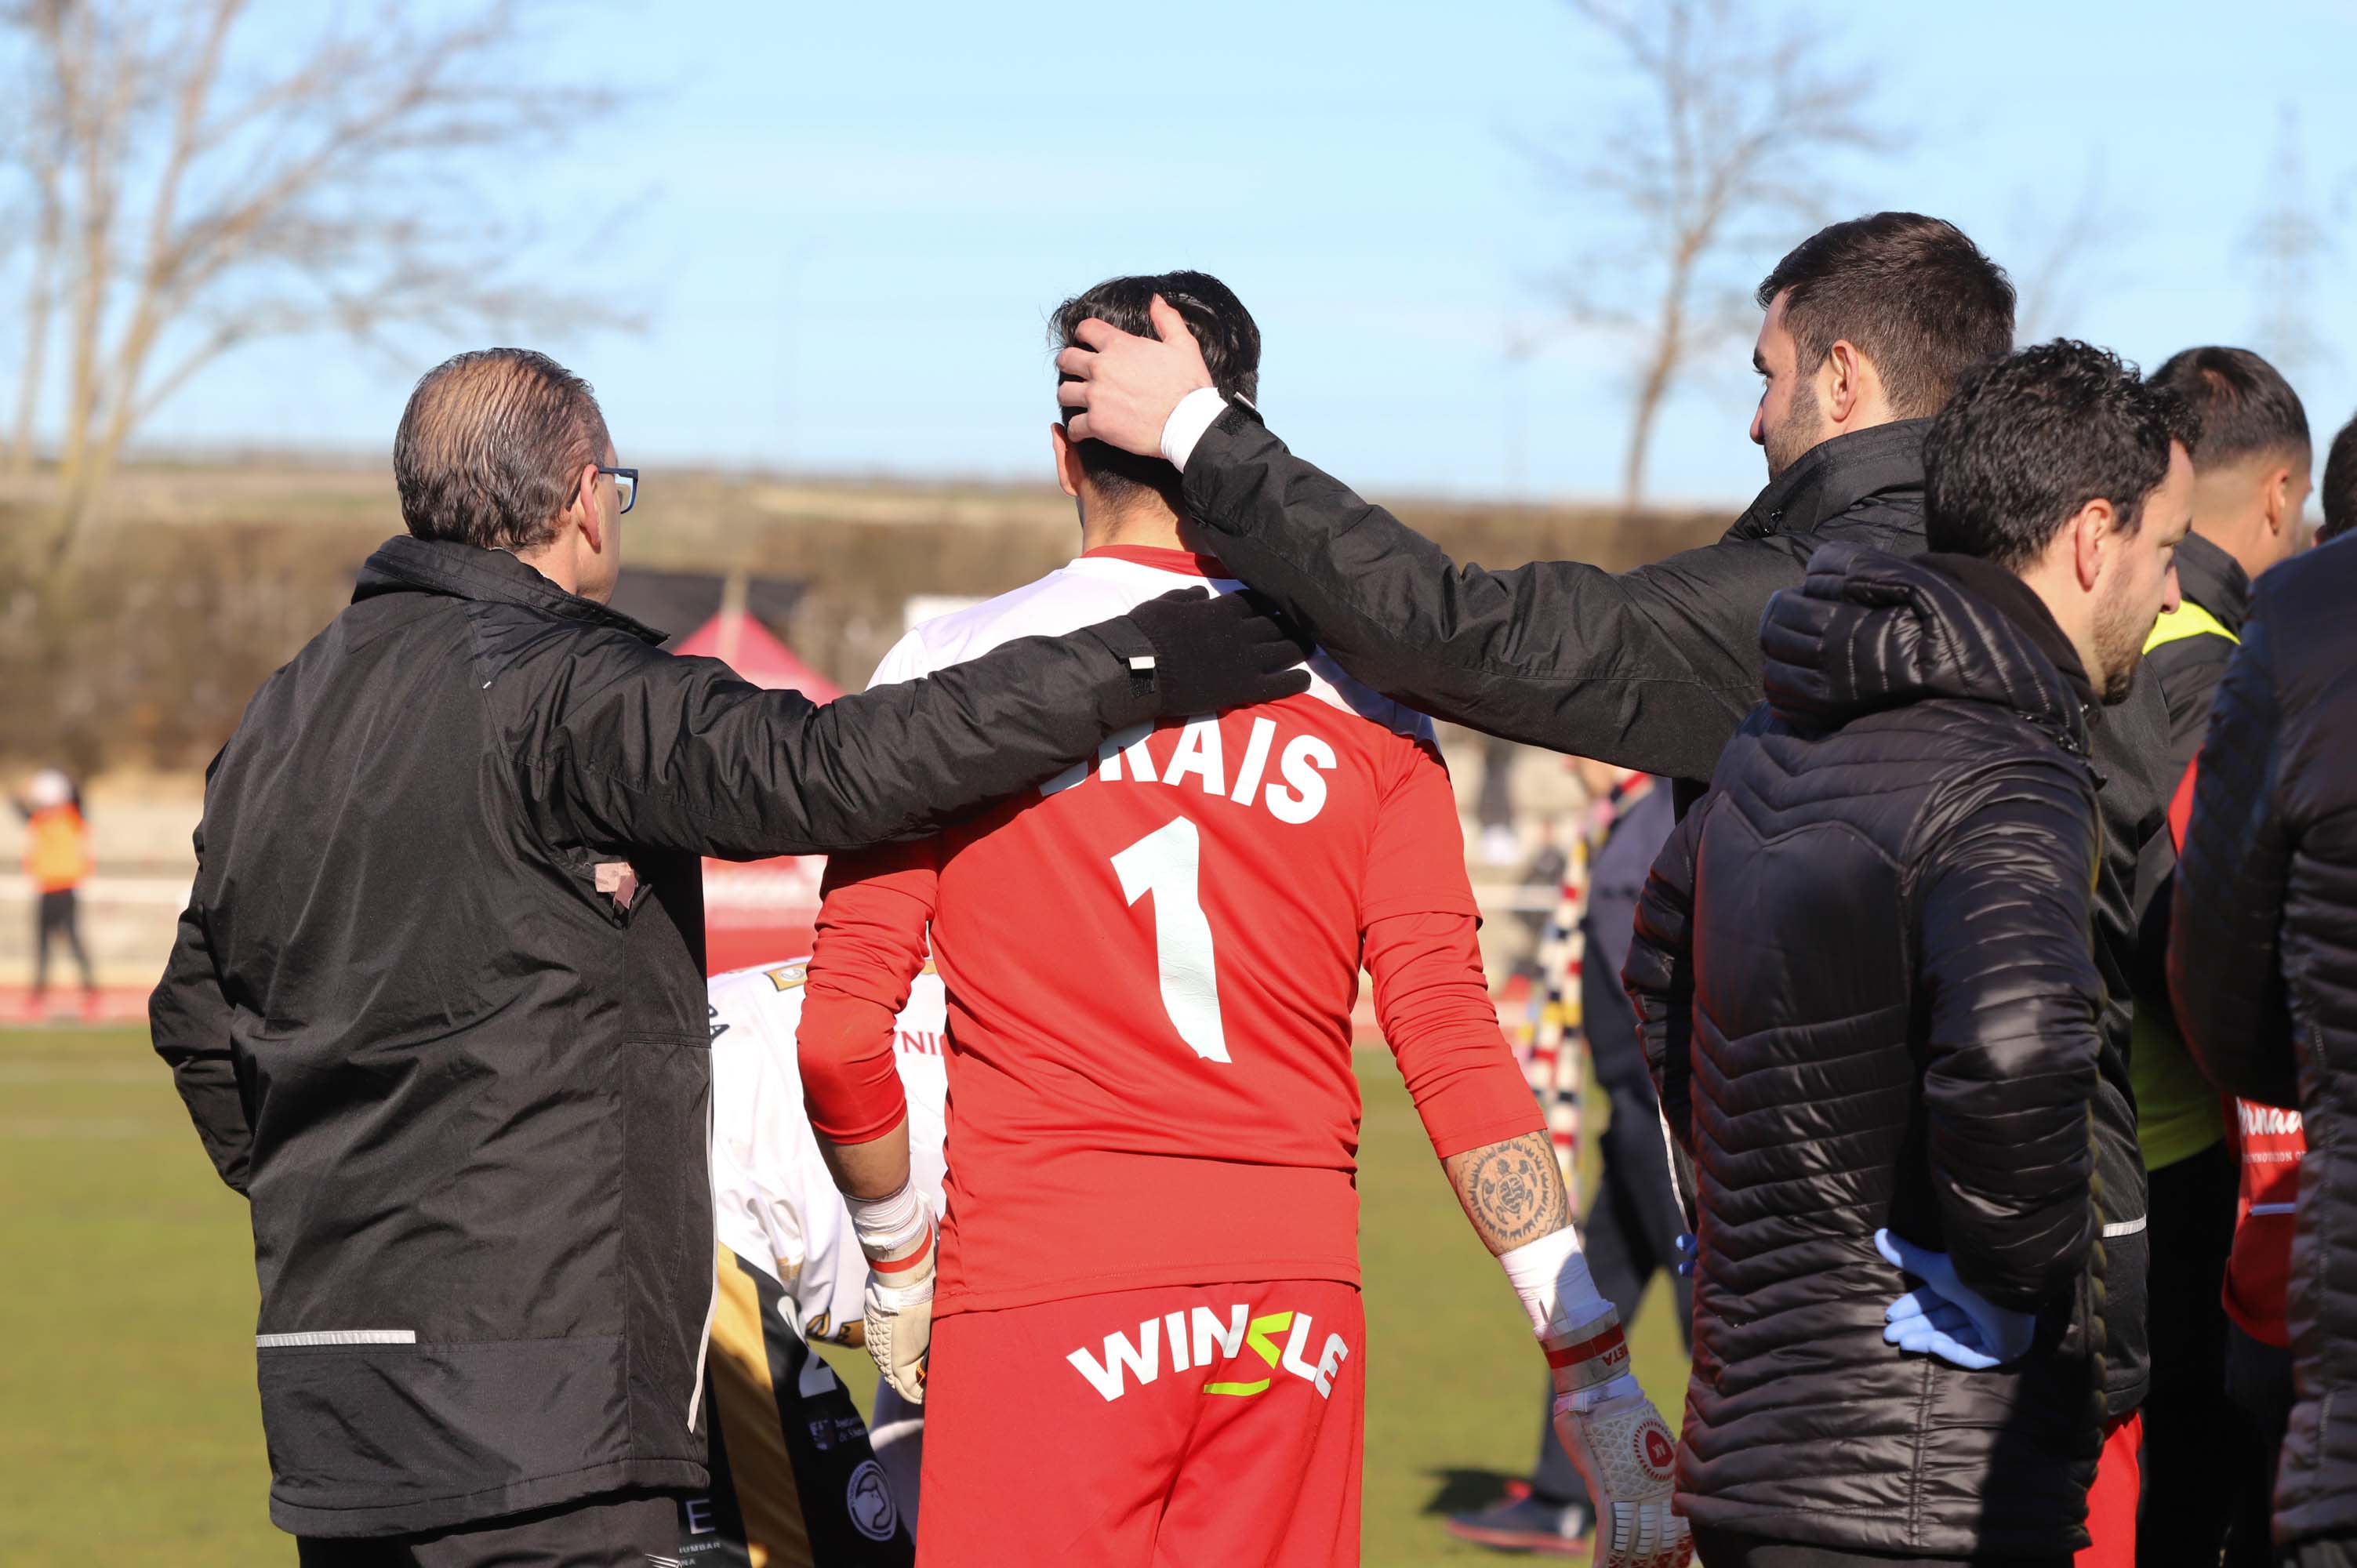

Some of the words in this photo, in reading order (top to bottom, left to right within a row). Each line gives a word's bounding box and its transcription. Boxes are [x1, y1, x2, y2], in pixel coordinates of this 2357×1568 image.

[1038, 712, 1337, 824] RAIS
[1109, 815, 1232, 1063] 1
[1066, 1304, 1349, 1402] WINKLE
